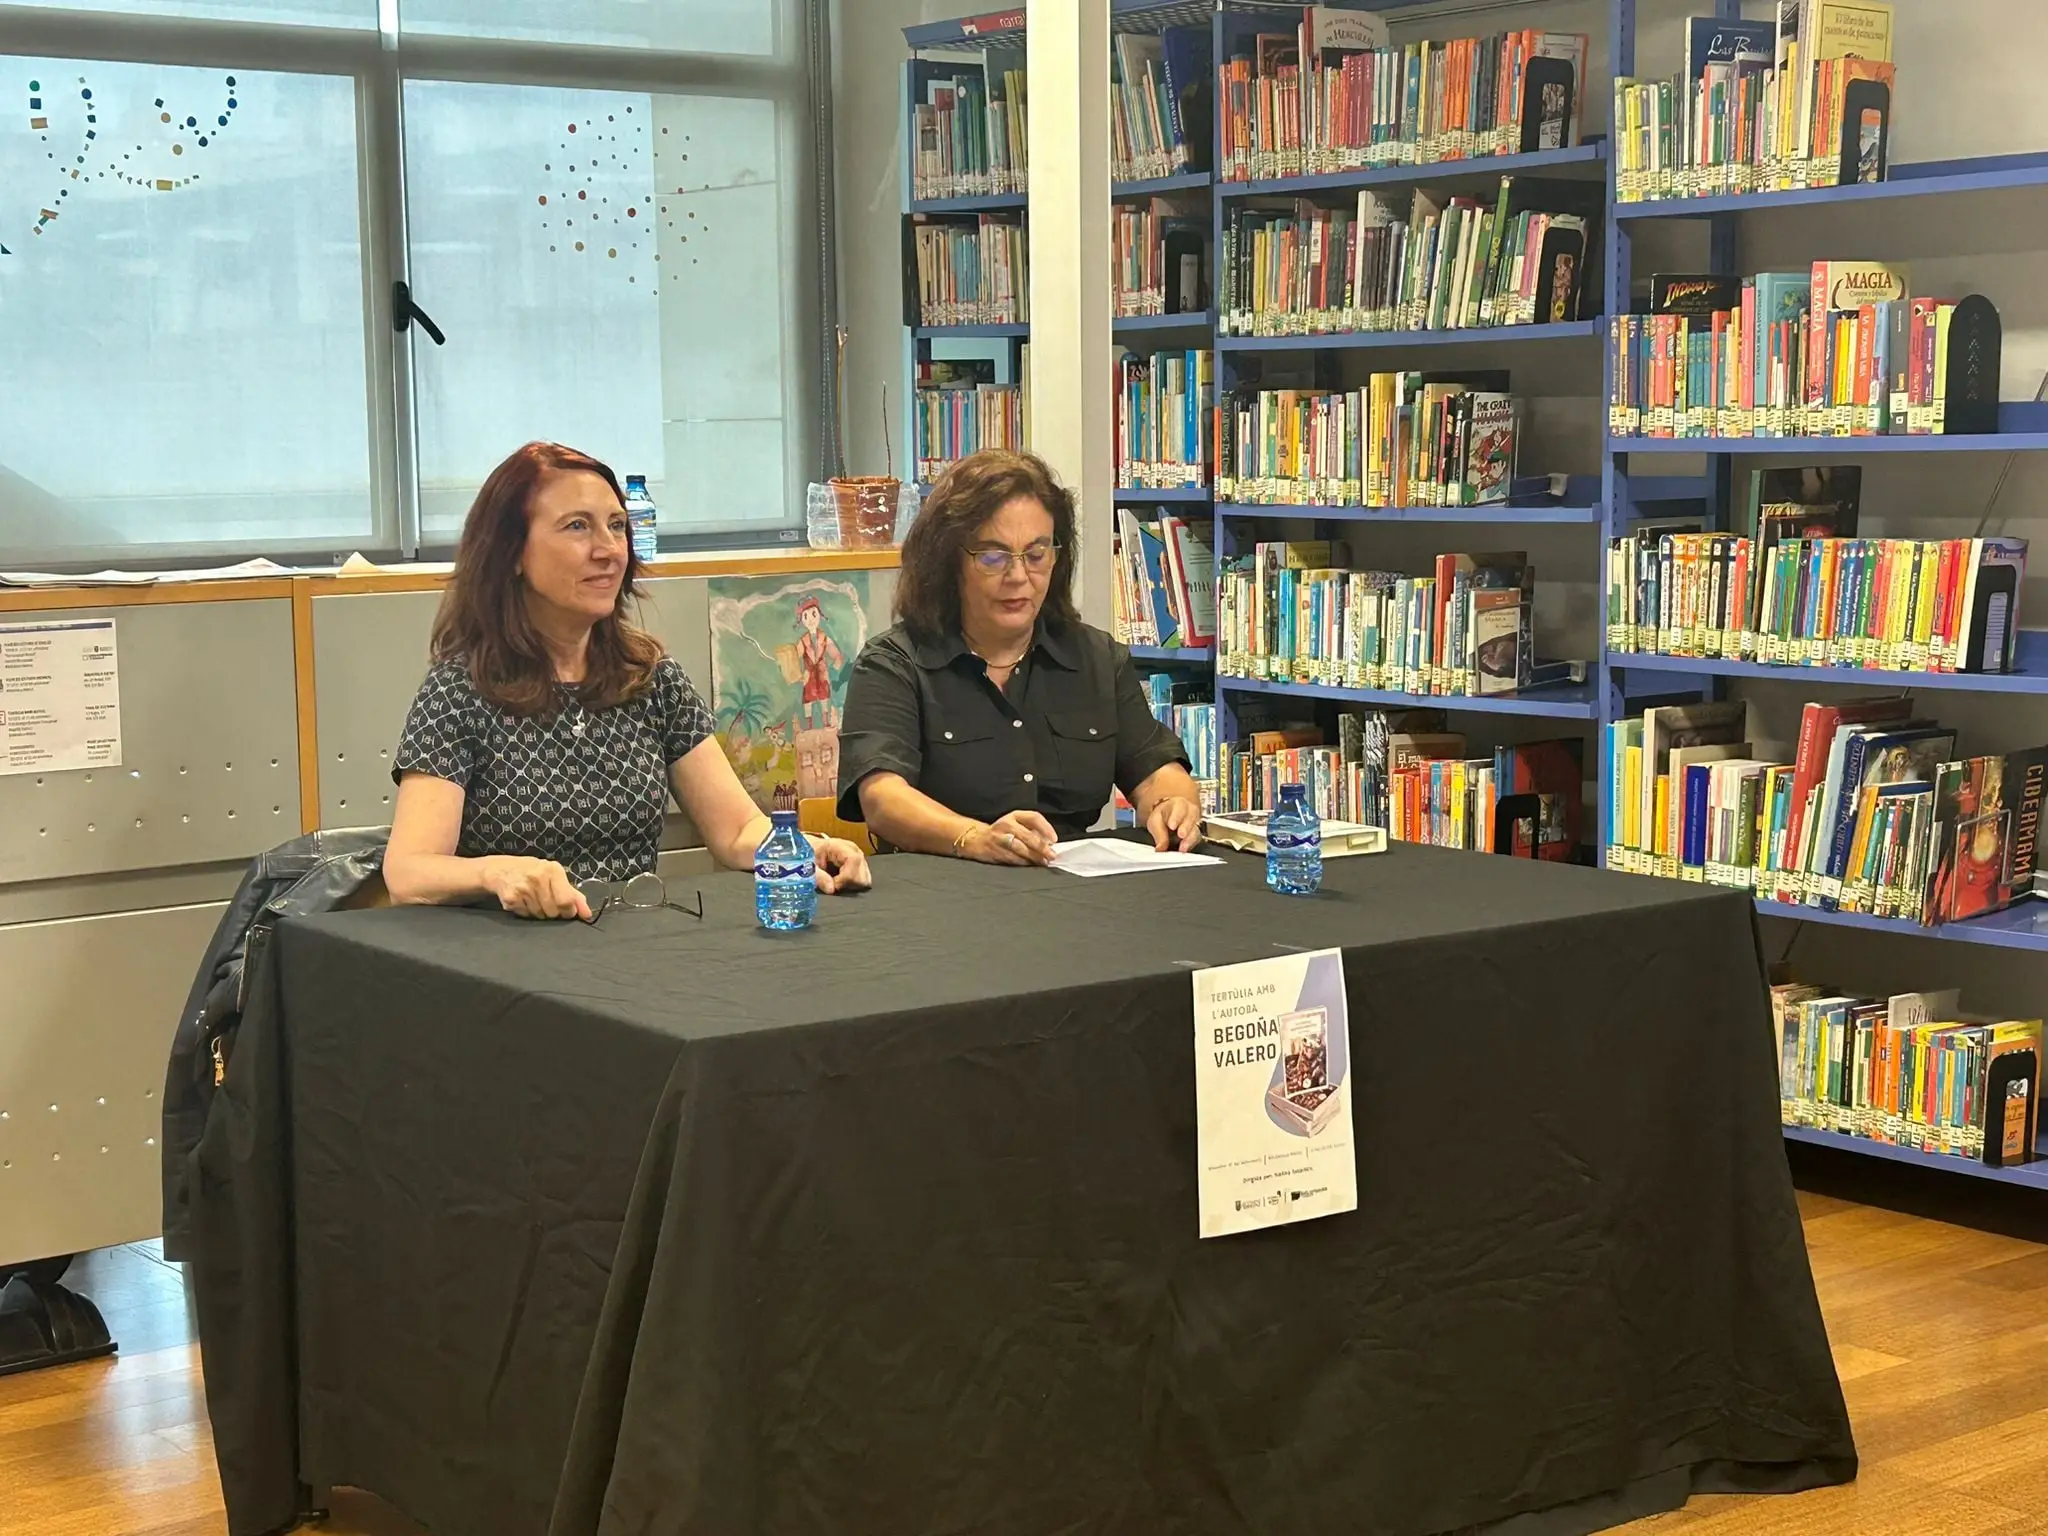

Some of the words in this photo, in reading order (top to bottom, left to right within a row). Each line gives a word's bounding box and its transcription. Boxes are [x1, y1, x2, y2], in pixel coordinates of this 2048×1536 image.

[1845, 272, 1893, 289] MAGIA
[1813, 287, 1824, 332] MAGIA
[1256, 984, 1276, 996] AMB
[1214, 1016, 1279, 1045] BEGOÑA
[1214, 1043, 1276, 1068] VALERO
